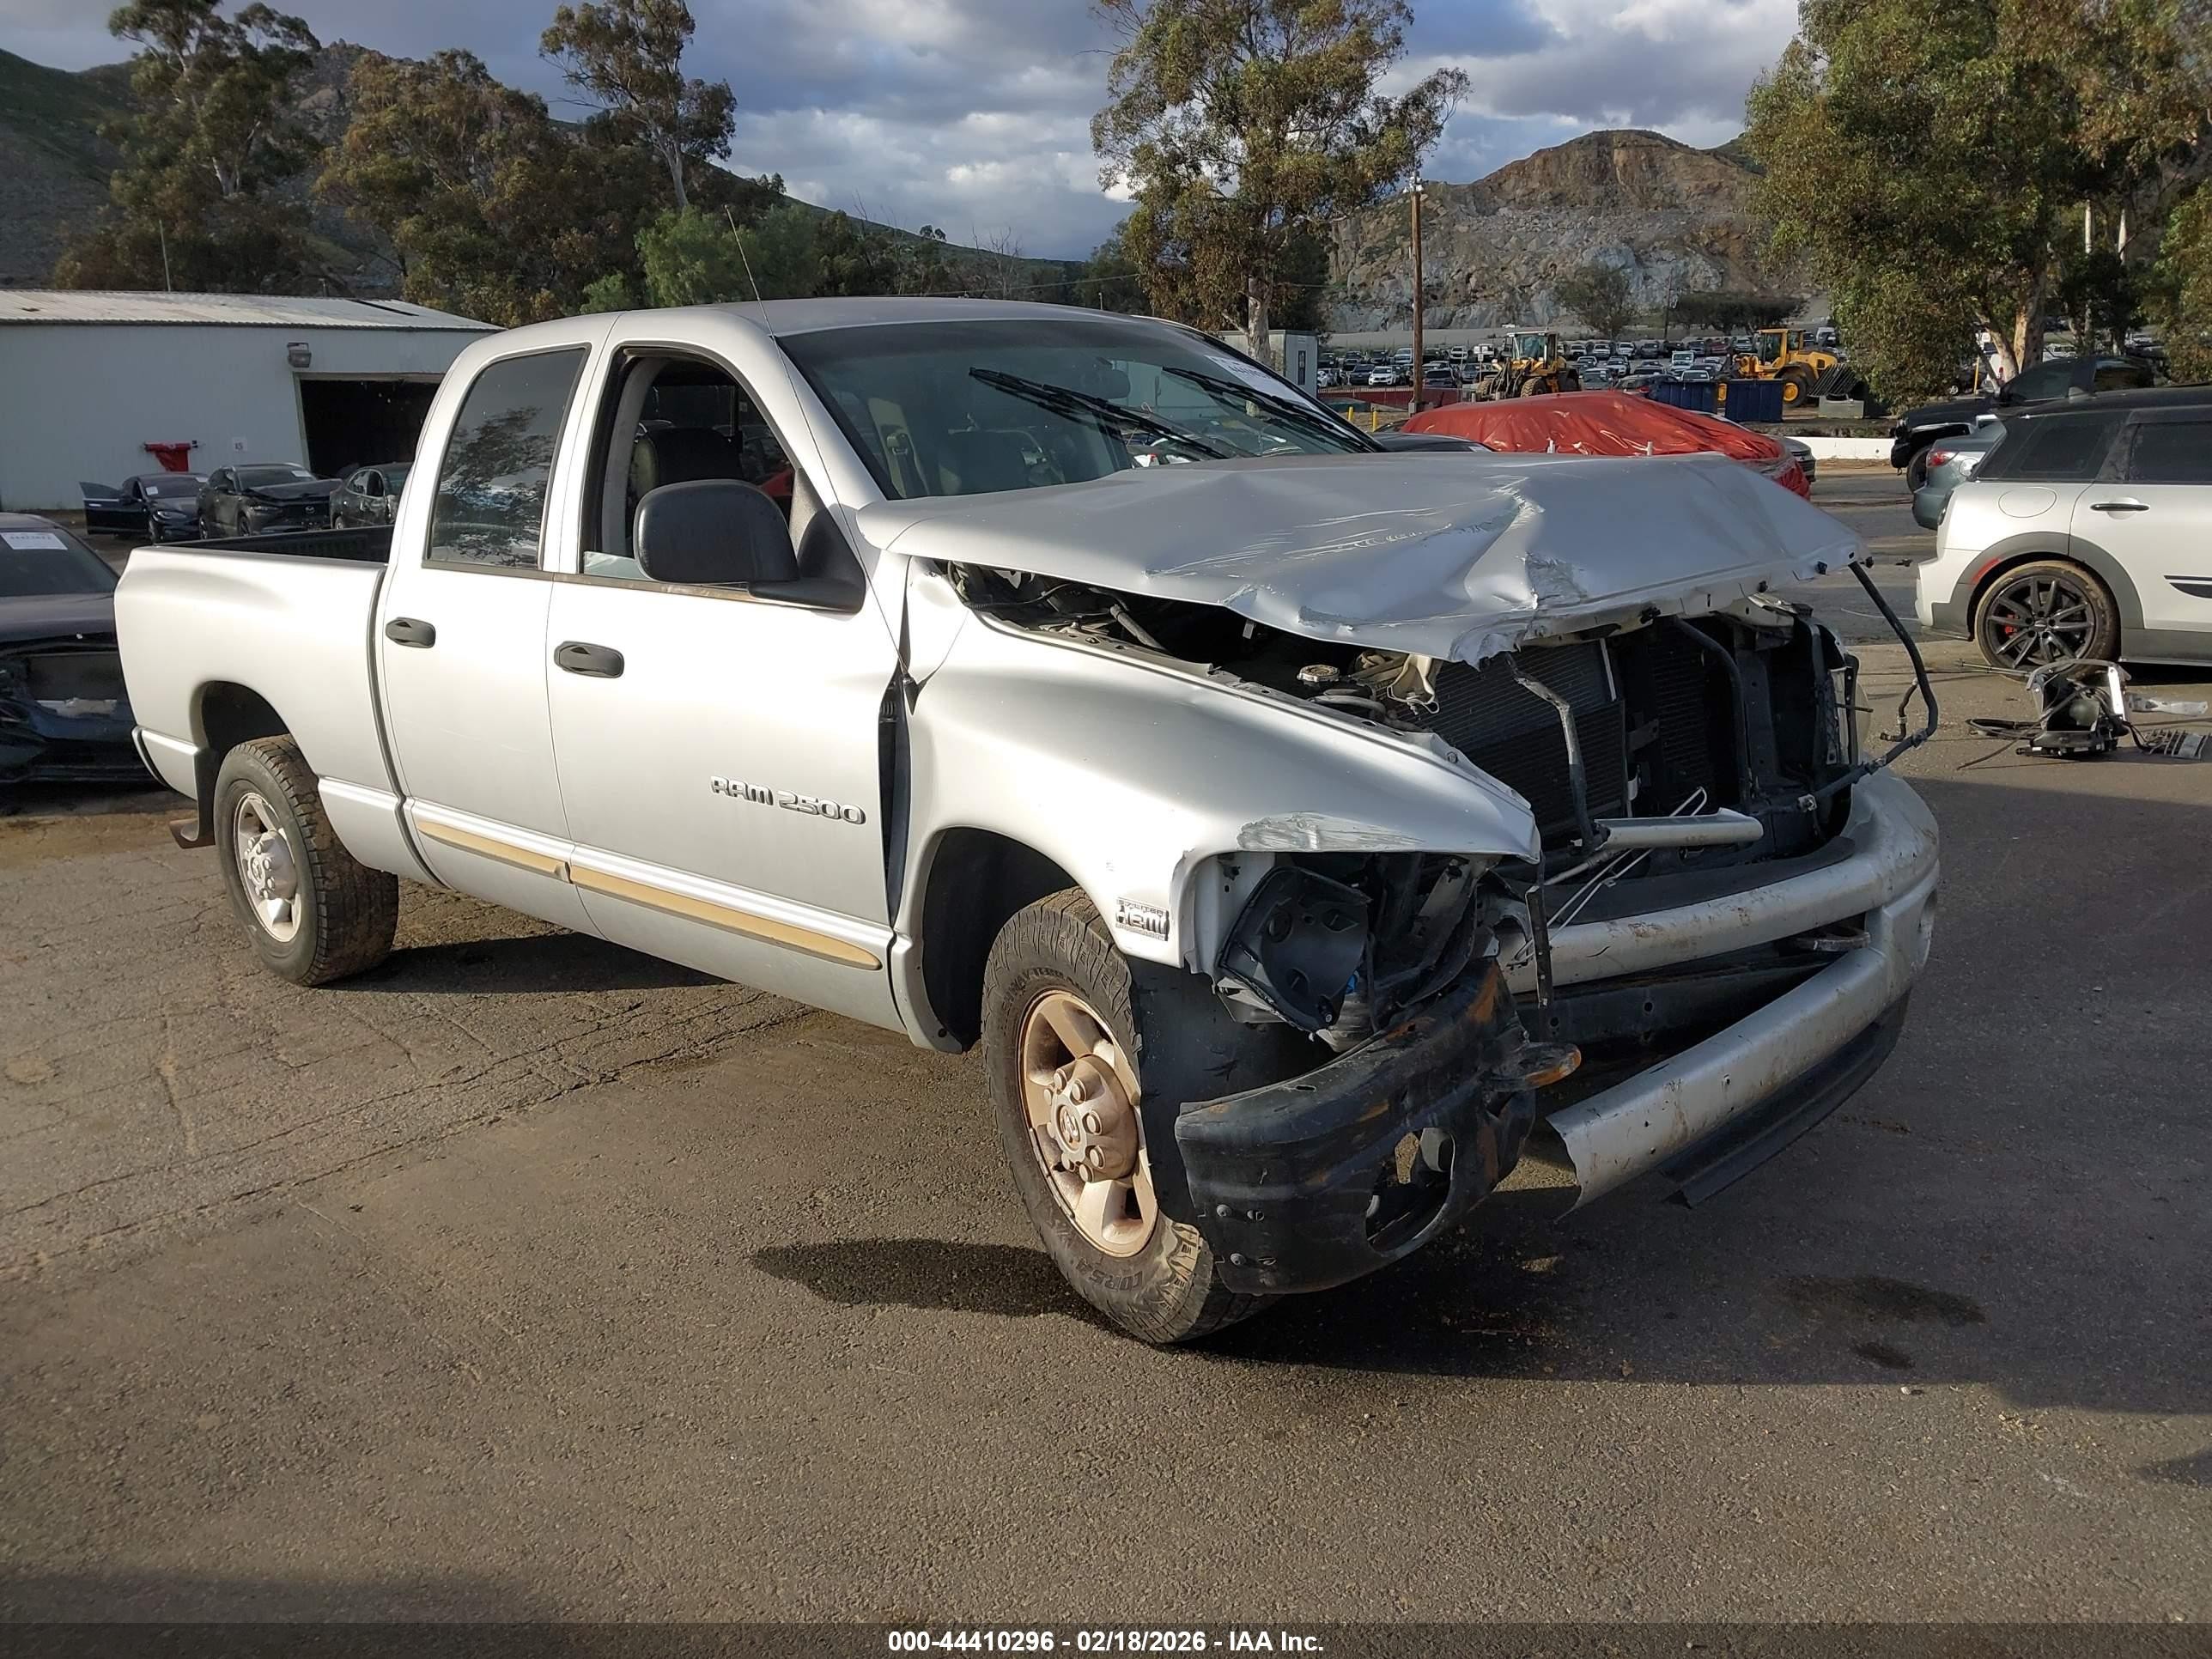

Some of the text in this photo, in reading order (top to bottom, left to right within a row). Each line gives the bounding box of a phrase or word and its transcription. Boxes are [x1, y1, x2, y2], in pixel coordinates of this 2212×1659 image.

[710, 775, 866, 825] RAM 2500
[1076, 1258, 1143, 1291] CORSA
